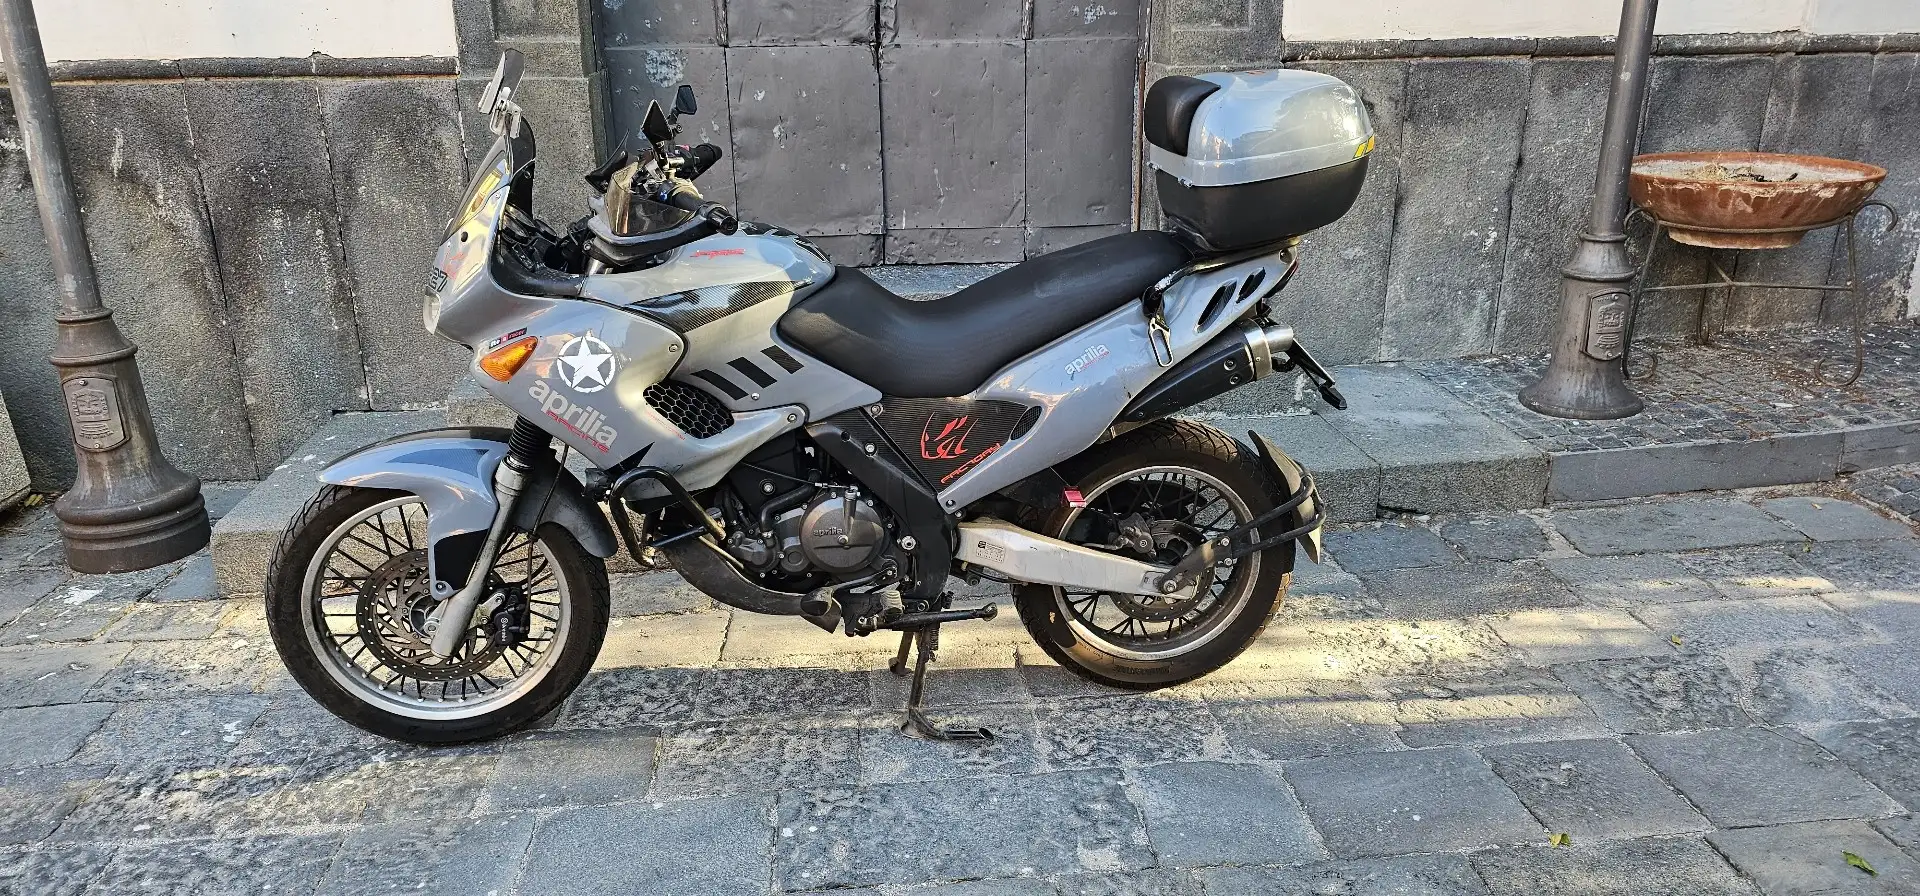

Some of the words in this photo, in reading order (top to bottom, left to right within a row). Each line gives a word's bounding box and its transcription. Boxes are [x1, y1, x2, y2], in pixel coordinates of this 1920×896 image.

[1065, 344, 1110, 373] aprilia
[528, 380, 618, 450] aprilia
[813, 526, 844, 537] aprilia
